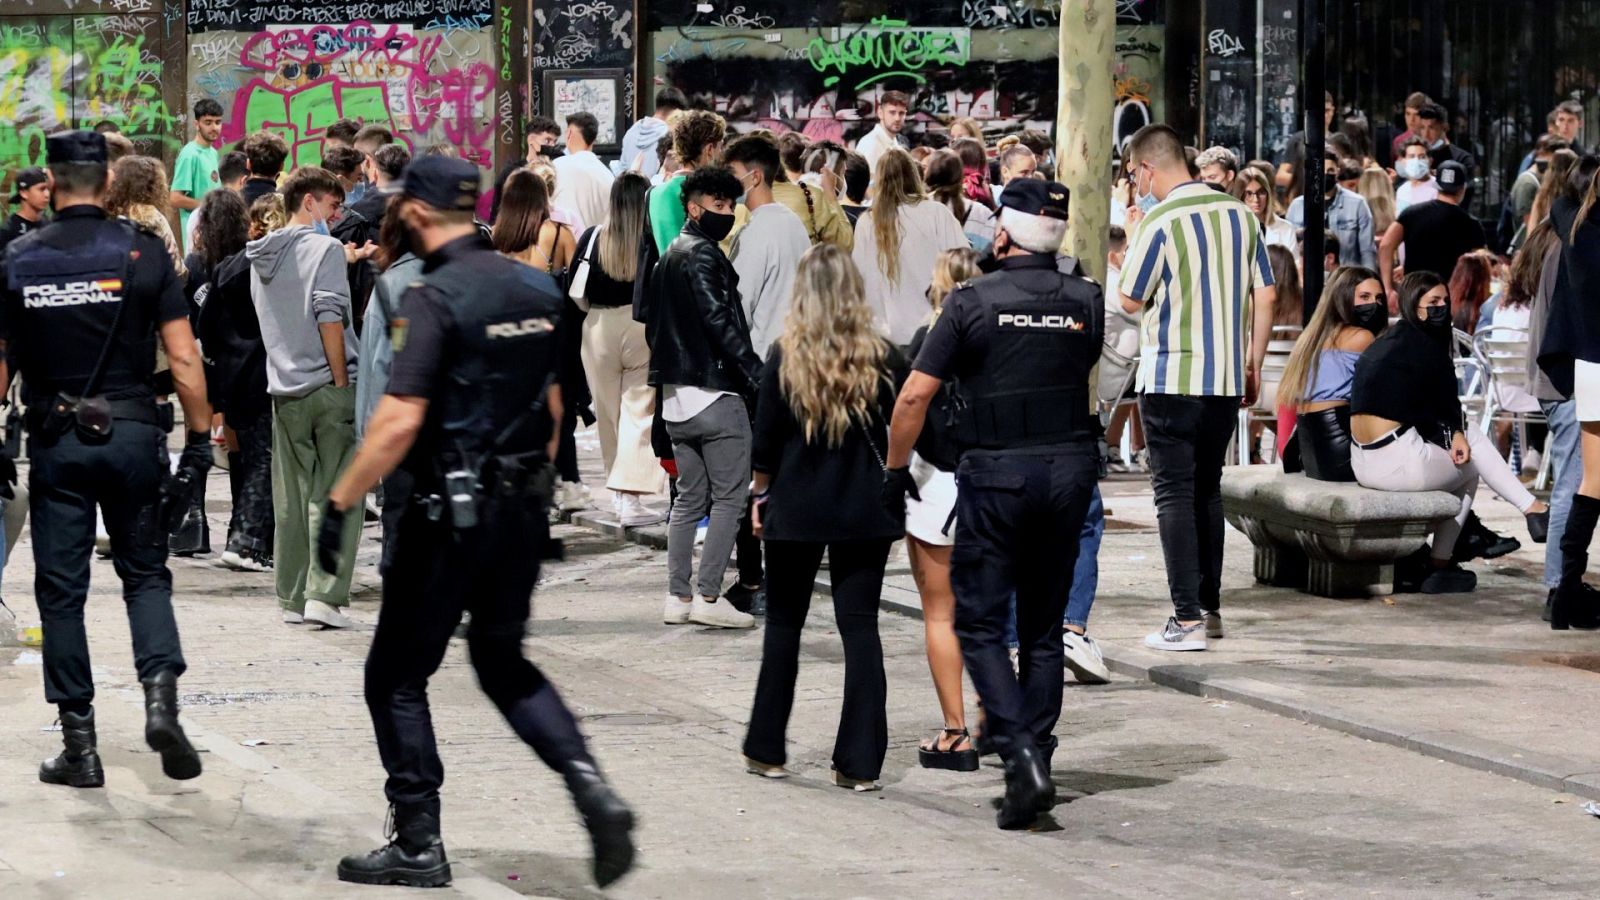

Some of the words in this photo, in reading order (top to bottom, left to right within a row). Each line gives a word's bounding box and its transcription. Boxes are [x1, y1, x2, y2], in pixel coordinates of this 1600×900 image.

[22, 280, 103, 297] POLICIA
[24, 292, 123, 308] NACIONAL
[998, 313, 1075, 328] POLICIA
